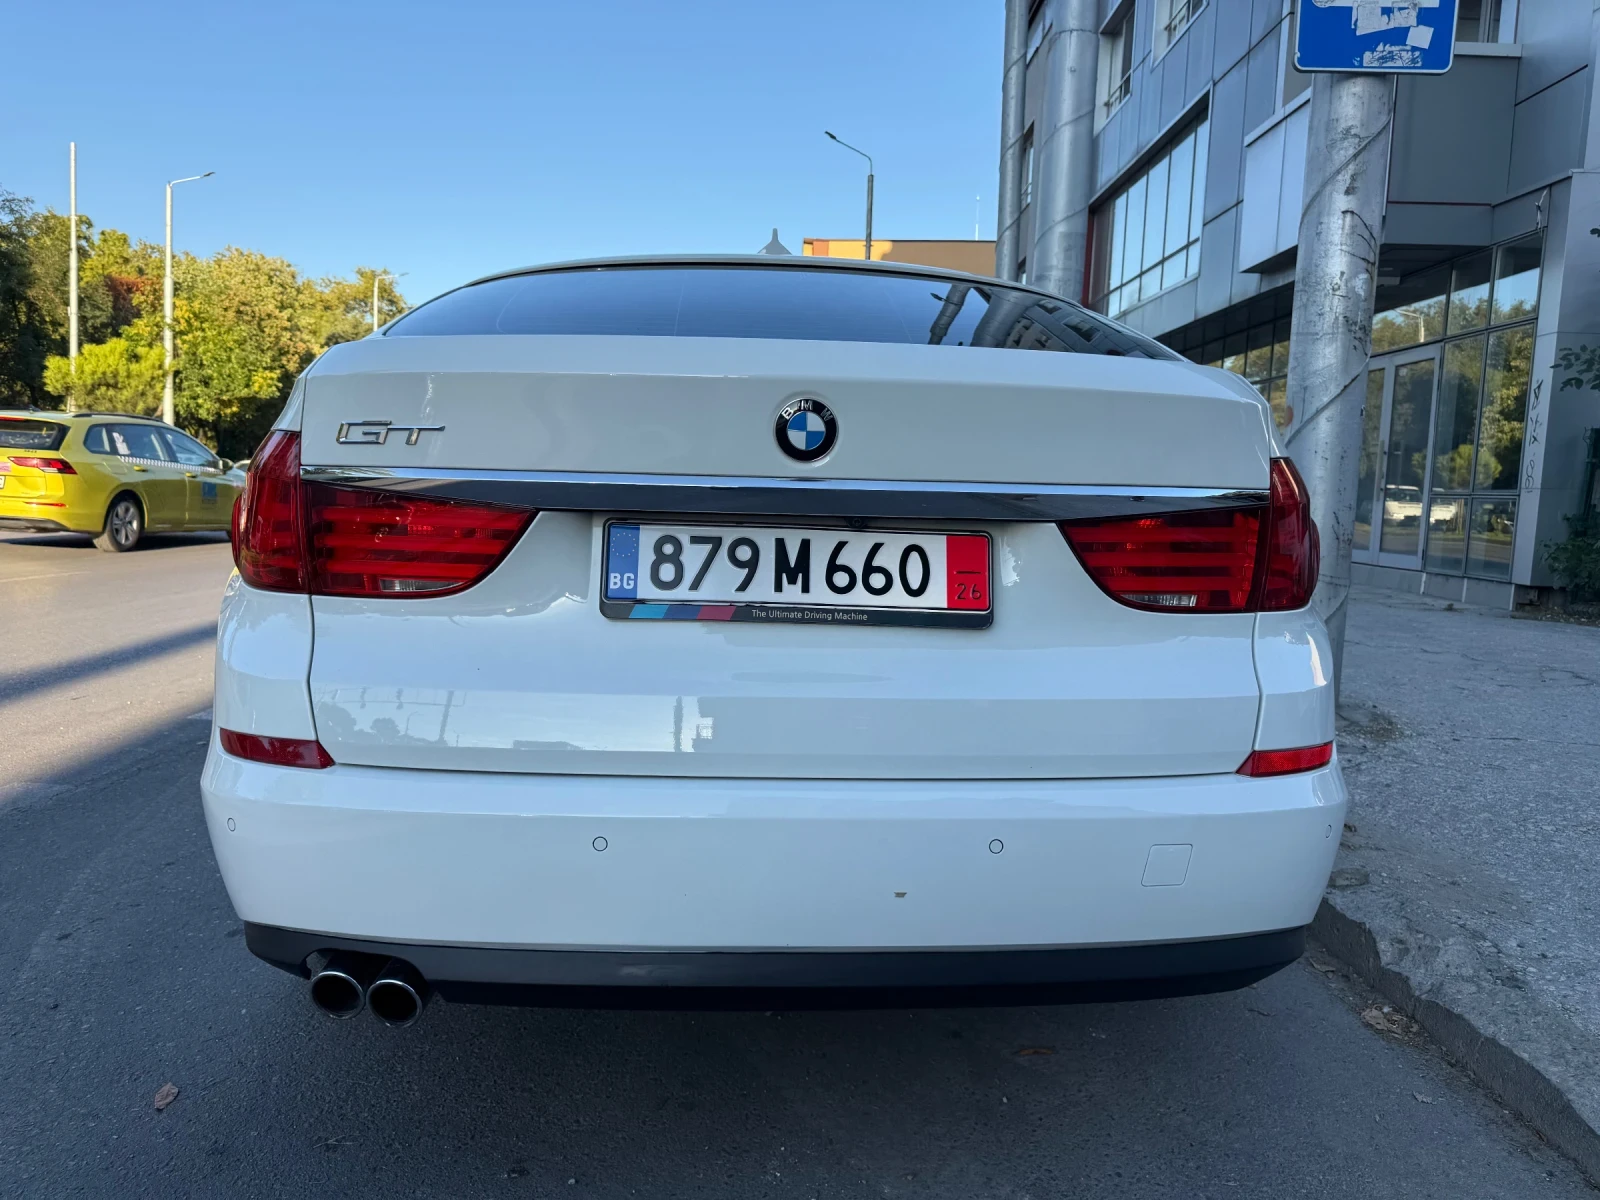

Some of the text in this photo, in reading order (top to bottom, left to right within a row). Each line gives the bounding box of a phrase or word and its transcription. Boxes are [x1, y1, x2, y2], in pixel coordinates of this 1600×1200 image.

[781, 399, 834, 421] BMW
[336, 420, 446, 445] GT
[651, 534, 931, 598] 879 M 660
[609, 572, 635, 590] BG
[955, 583, 982, 600] 26
[751, 609, 868, 621] The Ultimate Driving Machine
